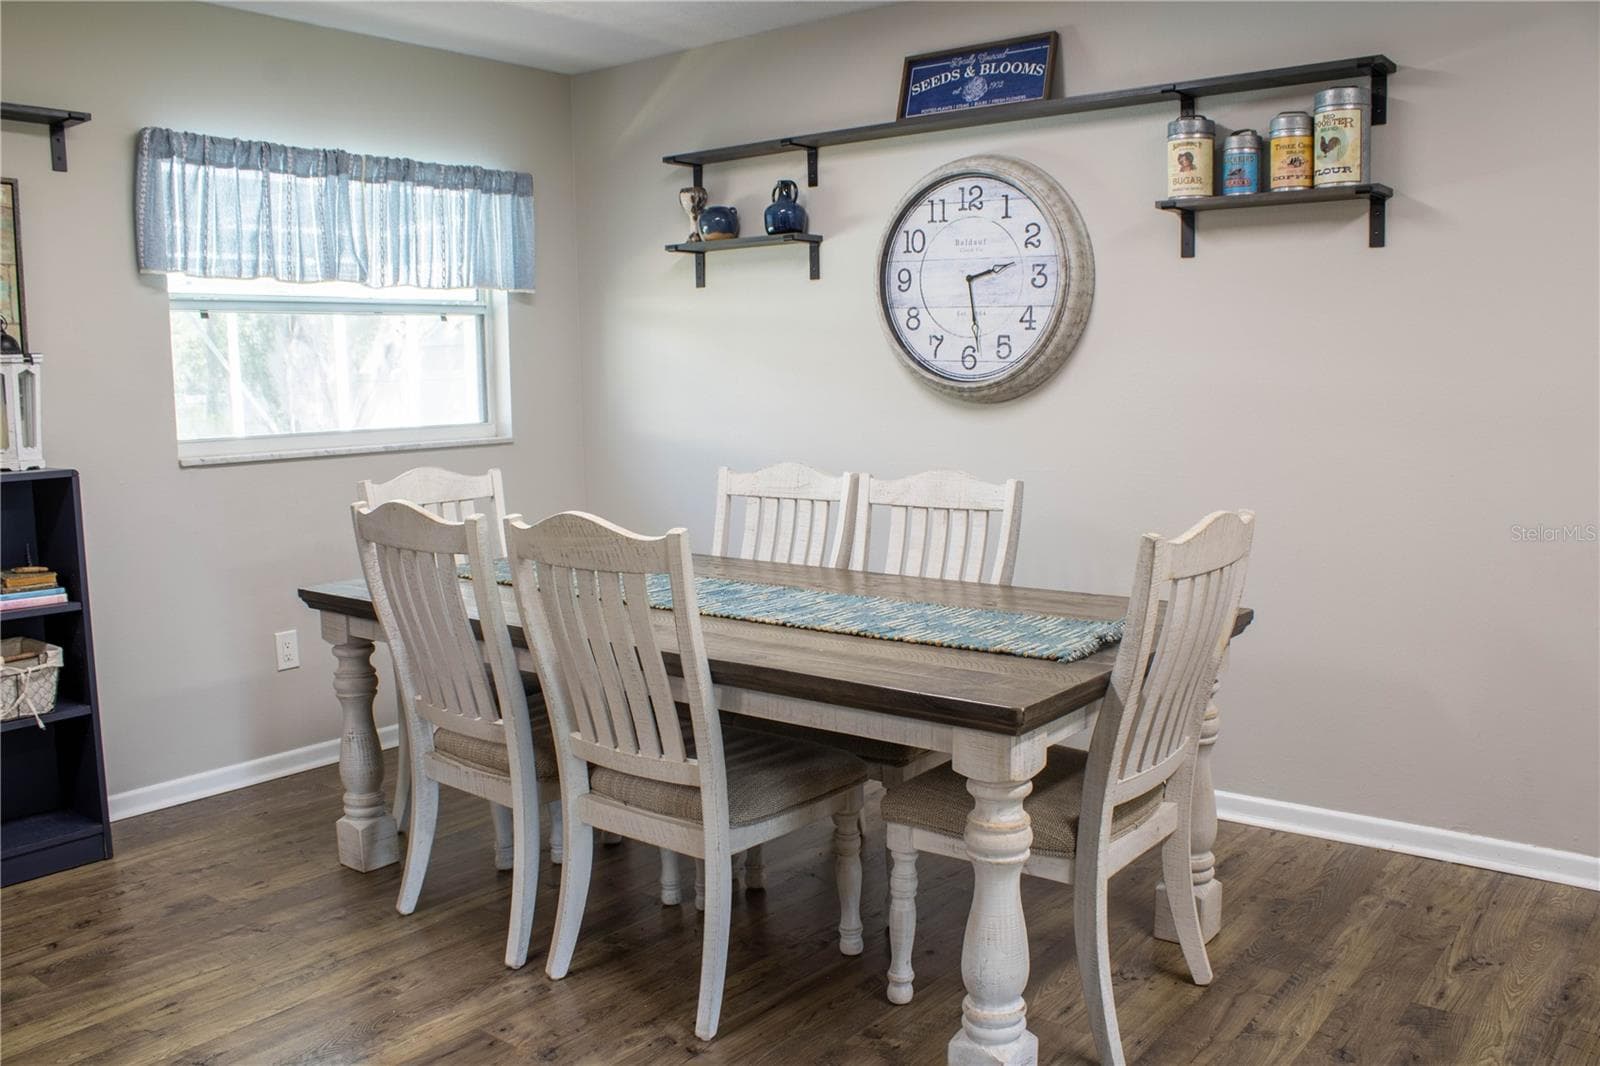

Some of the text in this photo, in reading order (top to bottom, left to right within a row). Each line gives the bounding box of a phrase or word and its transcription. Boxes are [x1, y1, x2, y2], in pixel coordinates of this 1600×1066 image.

[911, 61, 1046, 96] SEEDS & BLOOMS
[1172, 176, 1203, 186] SUGAR
[927, 199, 949, 224] 11
[958, 185, 984, 212] 12
[1001, 194, 1012, 220] 1
[903, 229, 926, 254] 10
[1024, 222, 1042, 249] 2
[897, 267, 912, 293] 9
[1031, 263, 1048, 289] 3
[905, 306, 921, 331] 8
[1019, 305, 1037, 331] 4
[929, 334, 945, 359] 7
[961, 345, 978, 371] 6
[996, 334, 1012, 360] 5
